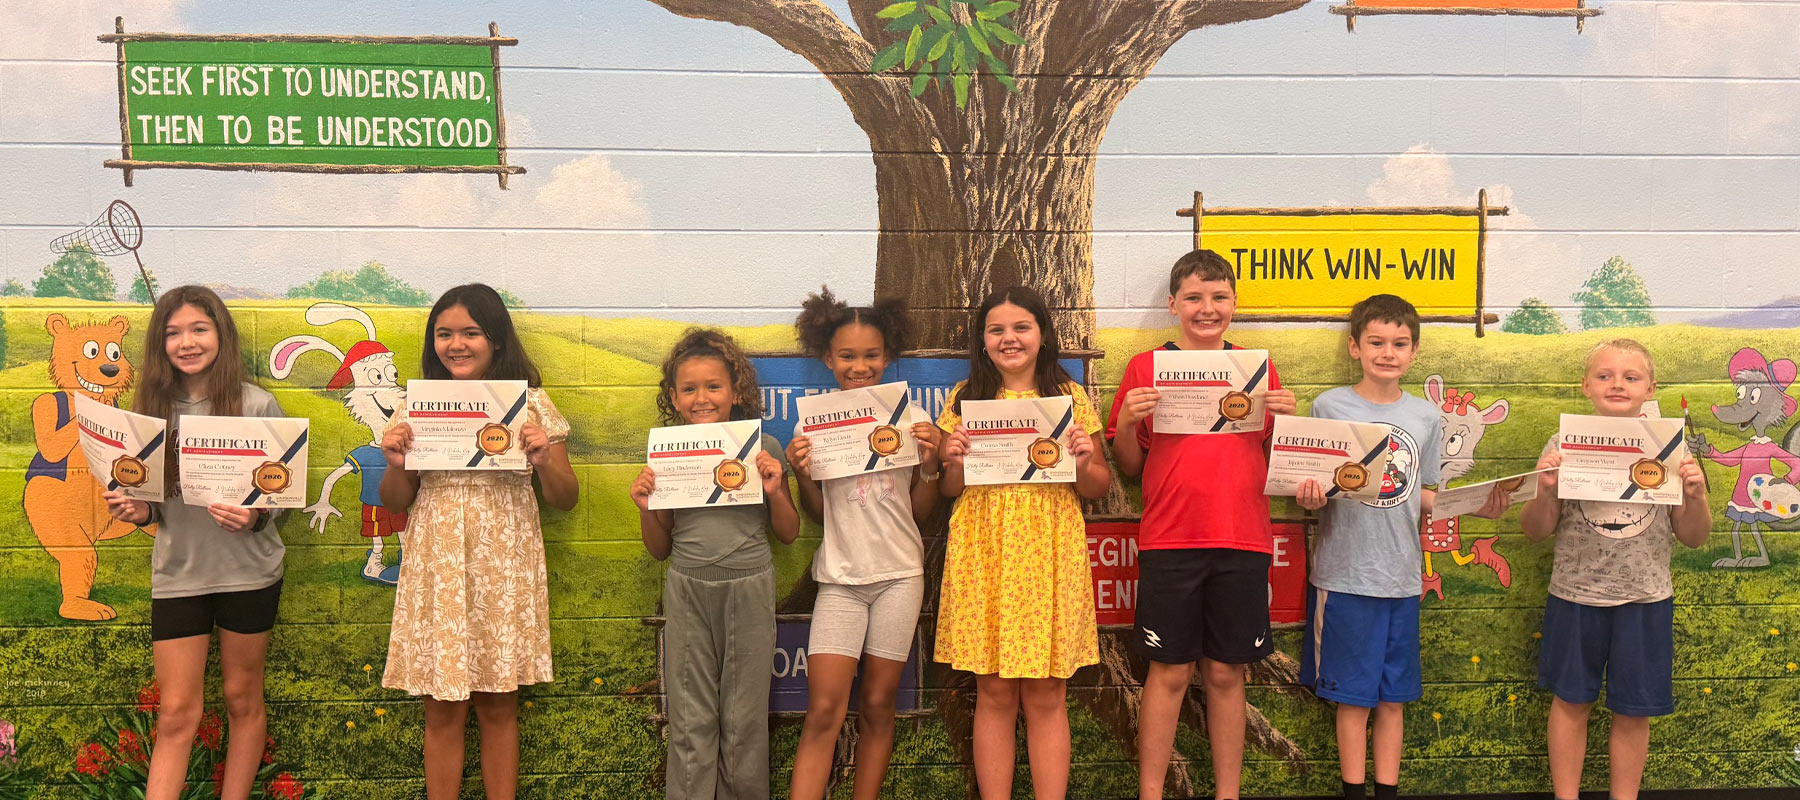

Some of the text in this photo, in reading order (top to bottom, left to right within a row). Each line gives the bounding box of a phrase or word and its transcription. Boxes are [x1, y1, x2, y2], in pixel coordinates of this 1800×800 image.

[130, 66, 491, 104] SEEK FIRST TO UNDERSTAND,
[137, 115, 492, 148] THEN TO BE UNDERSTOOD
[1230, 248, 1314, 280] THINK
[1159, 371, 1232, 381] CERTIFICATE
[412, 401, 490, 412] CERTIFICATE
[760, 389, 792, 421] UT
[804, 406, 877, 426] CERTIFICATE
[967, 419, 1039, 430] CERTIFICATE
[77, 413, 128, 443] CERTIFICATE
[185, 437, 268, 450] CERTIFICATE
[653, 440, 725, 452] CERTIFICATE
[1277, 435, 1352, 451] CERTIFICATE
[1565, 434, 1645, 448] CERTIFICATE
[120, 467, 139, 475] 2026
[1086, 537, 1138, 567] EGIN
[1098, 580, 1138, 609] EN
